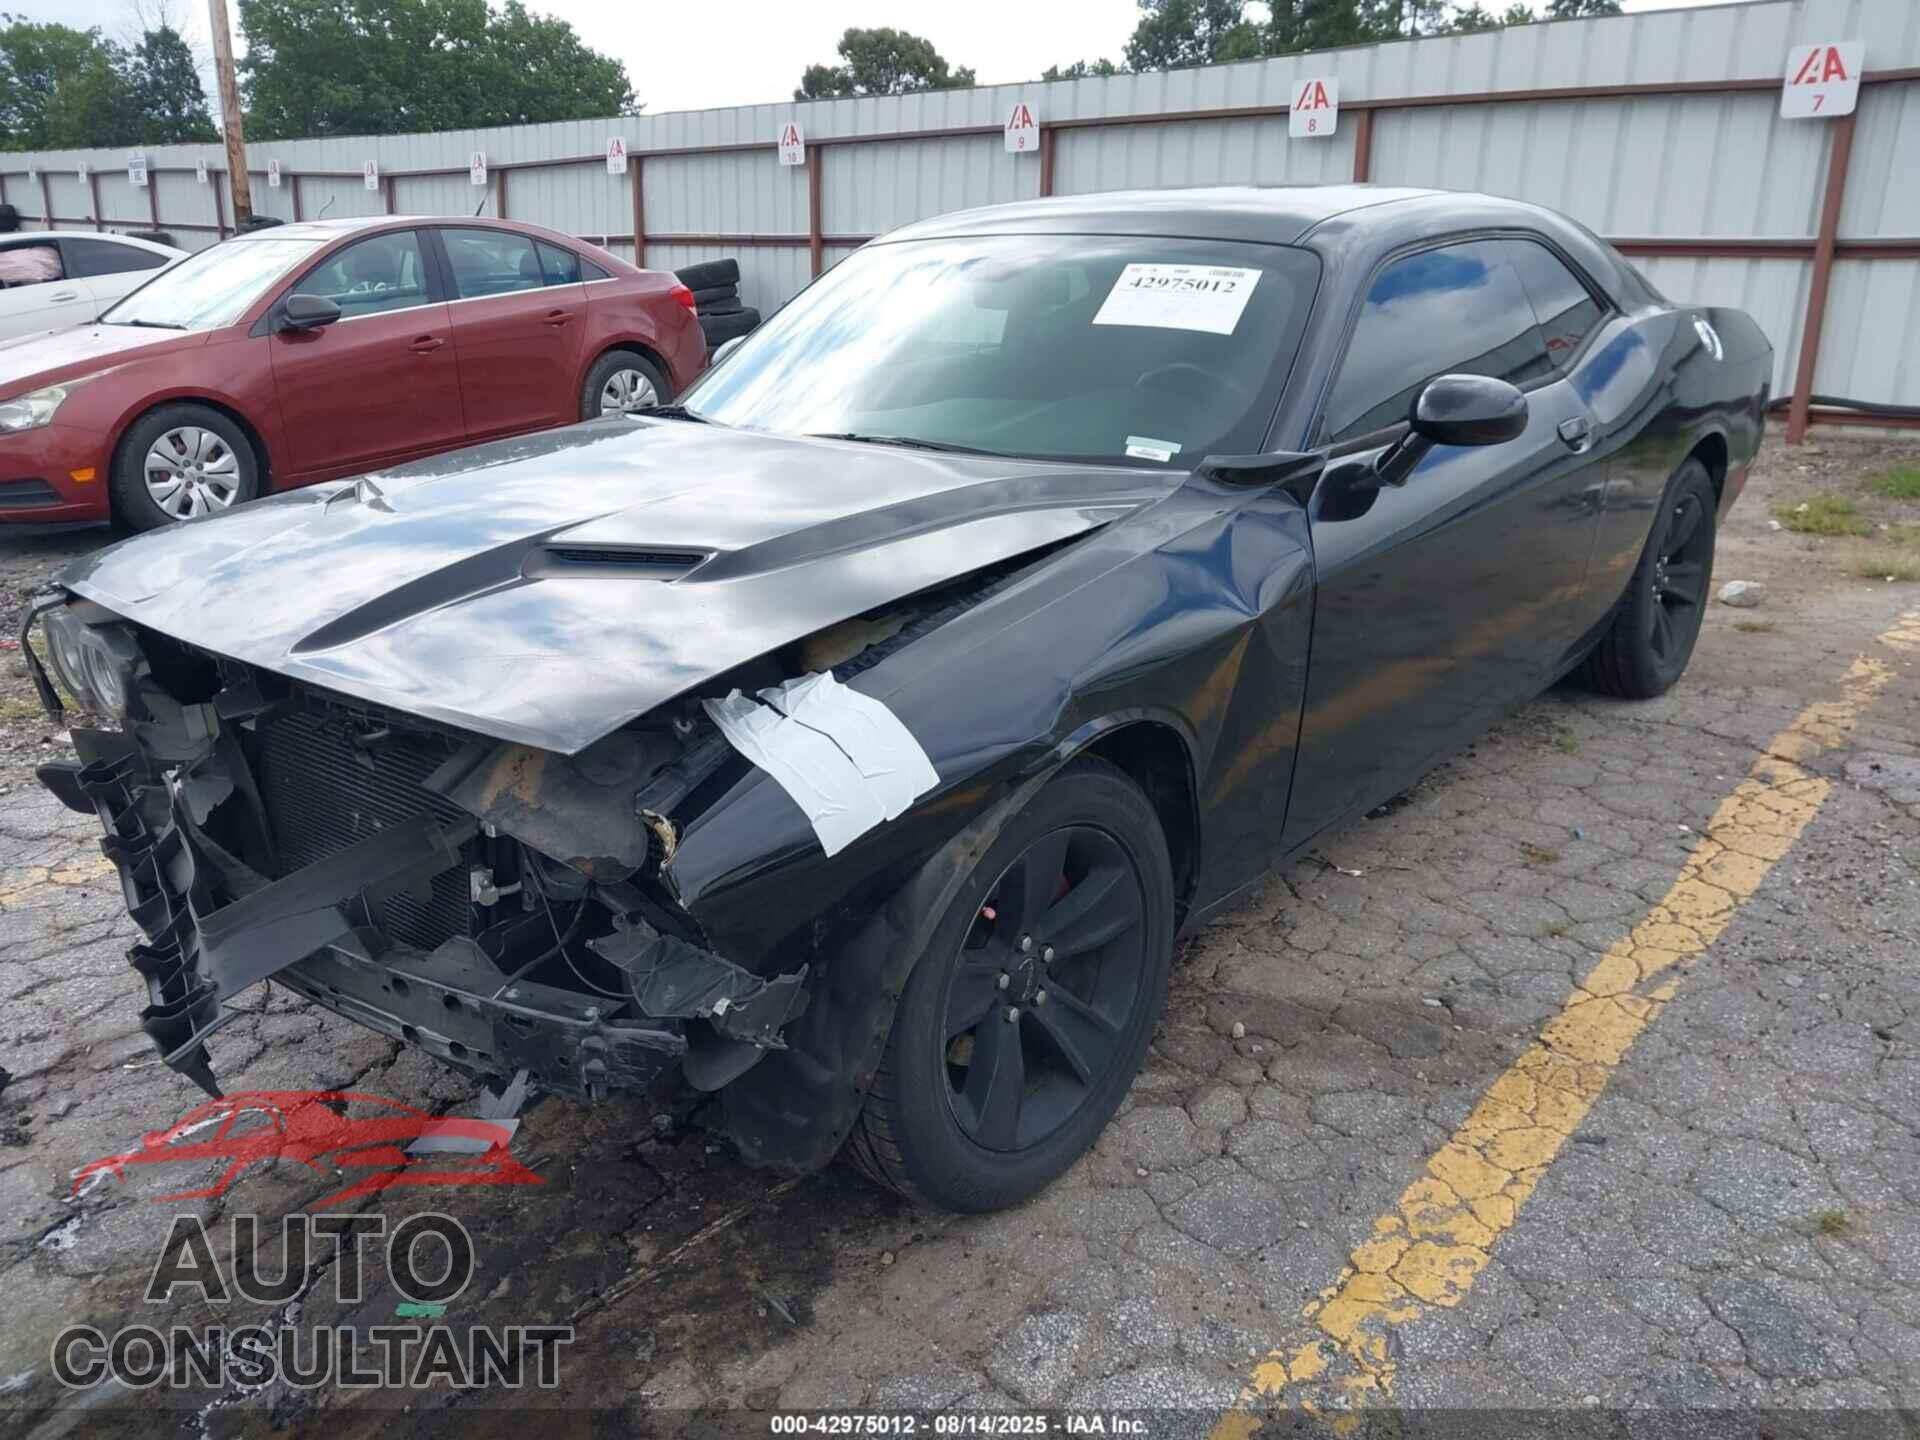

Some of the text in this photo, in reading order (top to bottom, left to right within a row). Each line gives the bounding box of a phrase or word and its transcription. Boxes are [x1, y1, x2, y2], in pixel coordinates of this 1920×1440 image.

[1813, 93, 1825, 112] 7
[1308, 118, 1317, 133] 8
[1018, 135, 1026, 149] 9
[1129, 276, 1237, 293] 42975012
